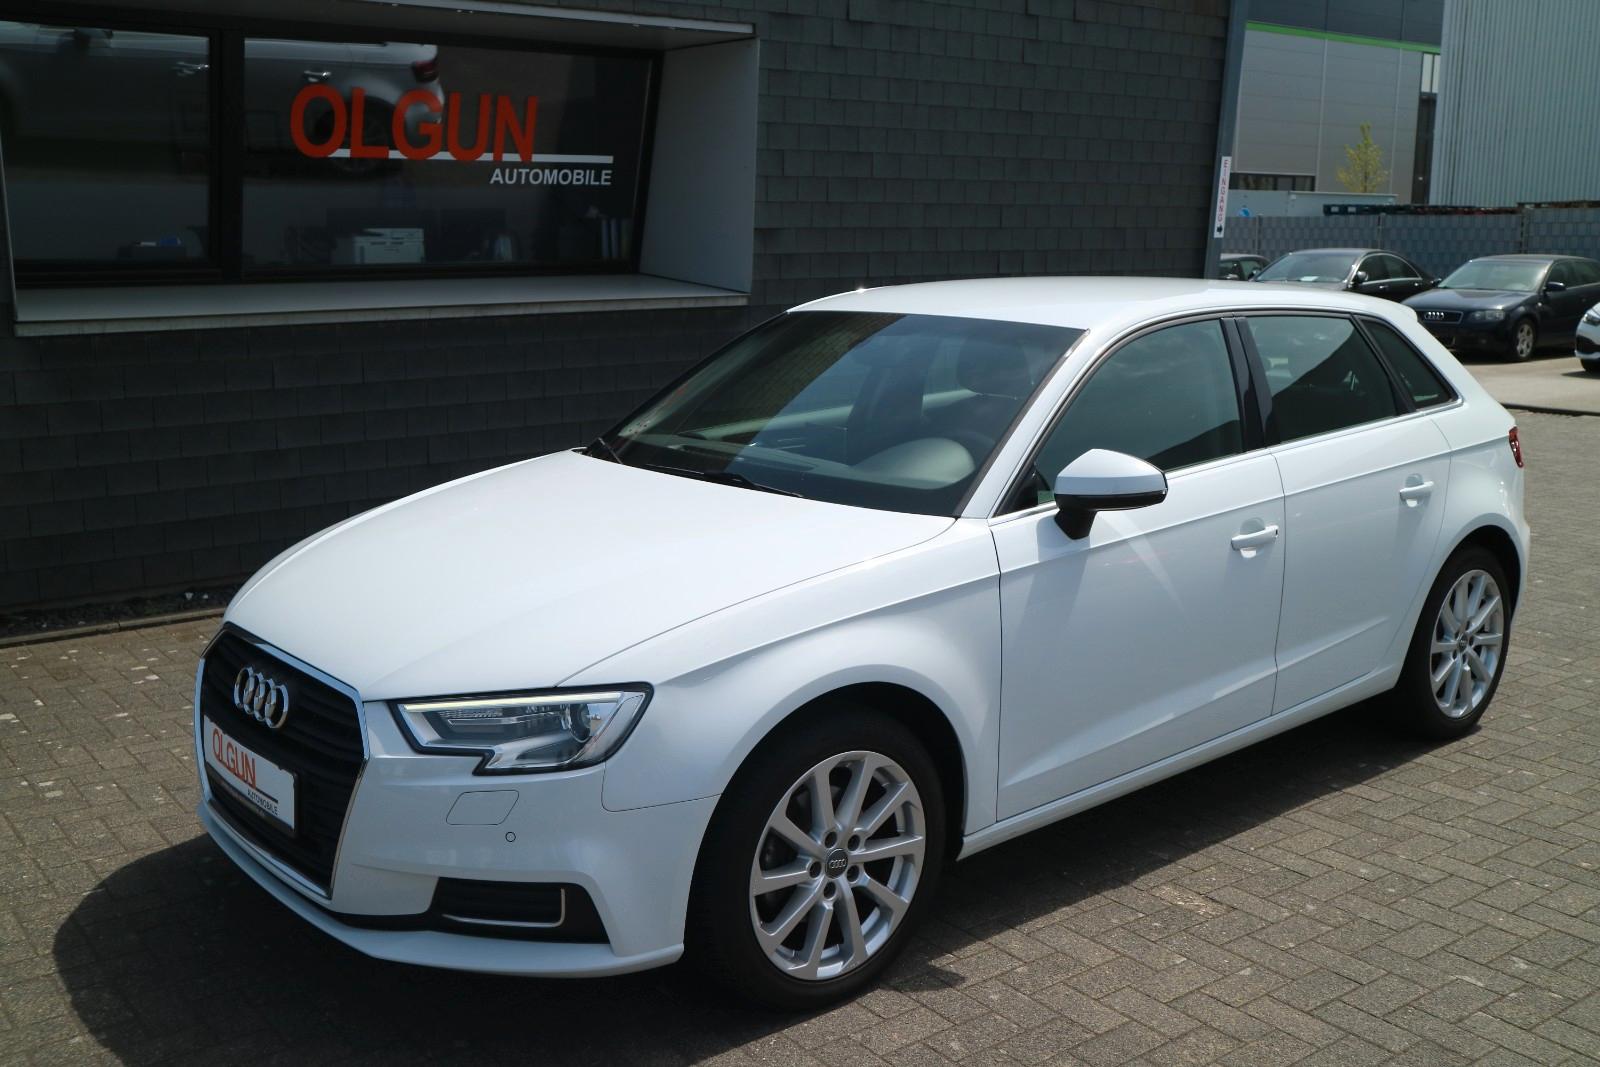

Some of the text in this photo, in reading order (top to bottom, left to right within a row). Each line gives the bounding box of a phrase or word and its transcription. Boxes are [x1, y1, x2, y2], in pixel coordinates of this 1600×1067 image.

[290, 83, 538, 162] OLGUN
[490, 168, 612, 186] AUTOMOBILE
[1217, 159, 1229, 222] EINGANG
[212, 728, 256, 790] OLGUN
[247, 789, 279, 816] AUTOMOBILE
